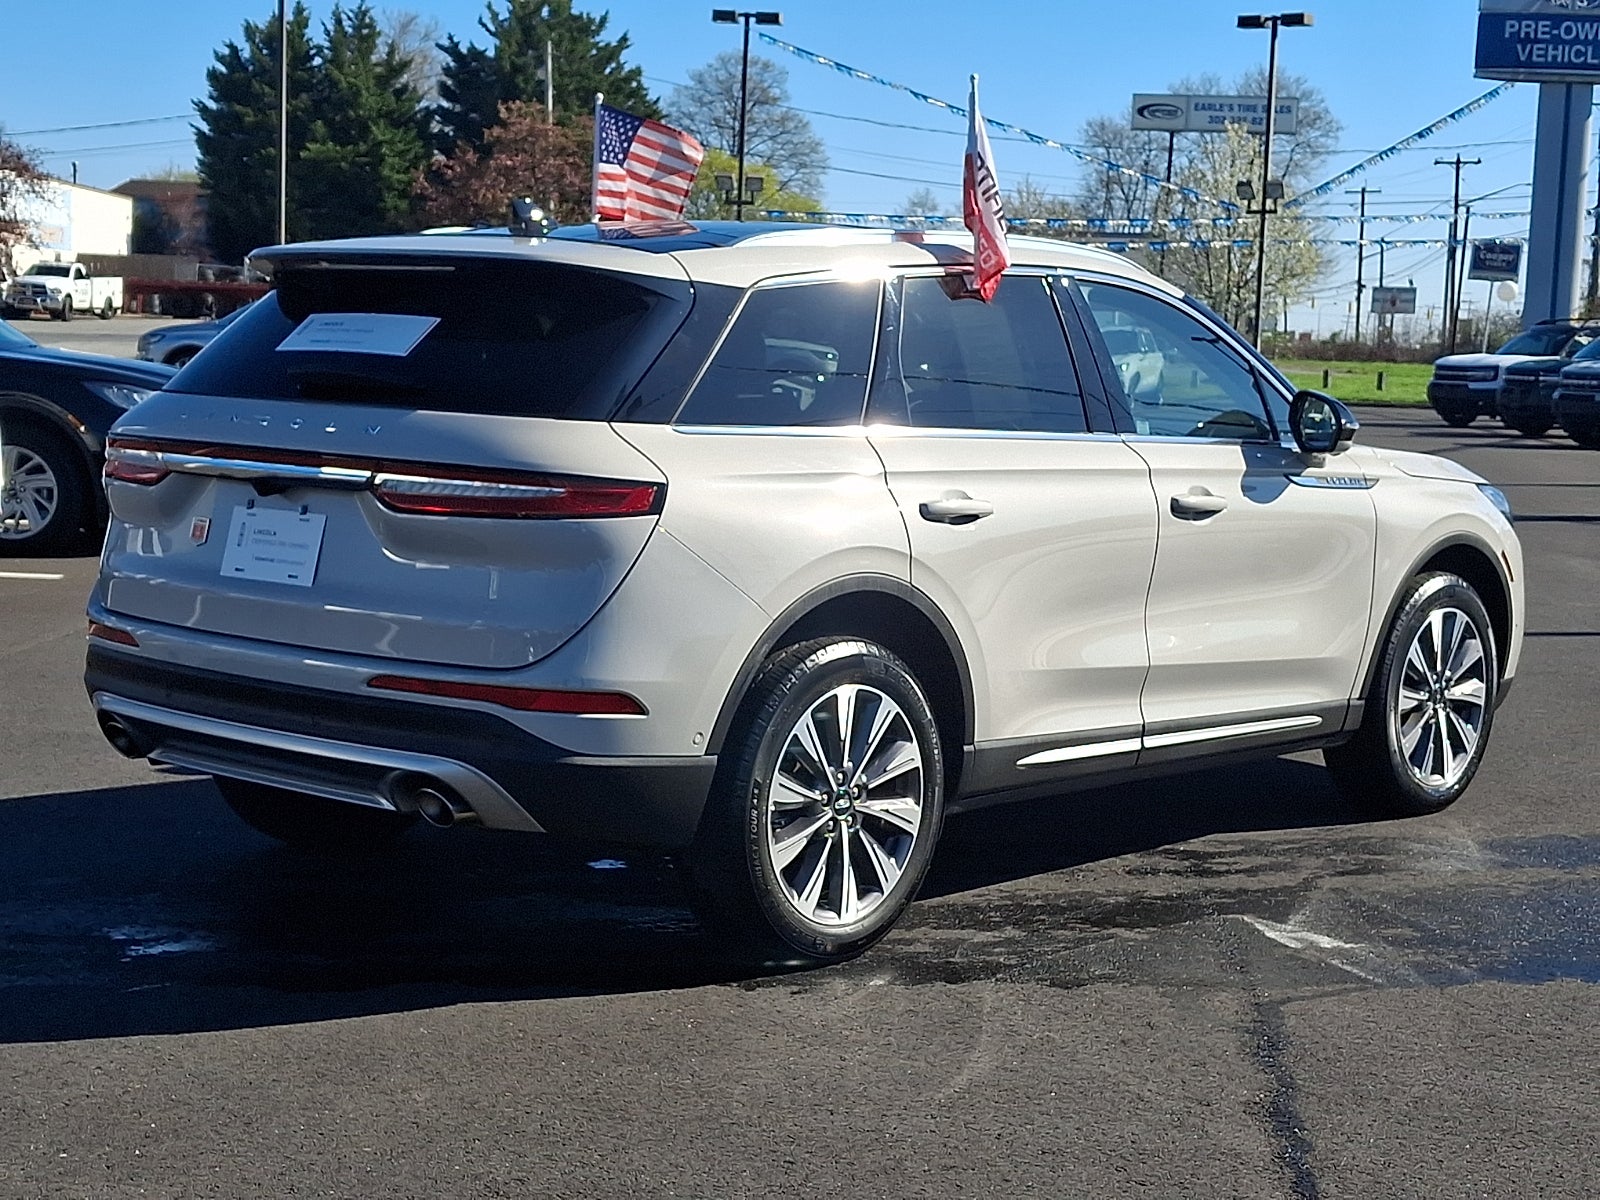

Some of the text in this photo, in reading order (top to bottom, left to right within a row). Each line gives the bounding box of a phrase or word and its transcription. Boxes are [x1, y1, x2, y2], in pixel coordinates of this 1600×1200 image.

[1504, 20, 1600, 40] PRE-OW
[1261, 104, 1292, 114] SLES
[750, 808, 759, 839] TOUR
